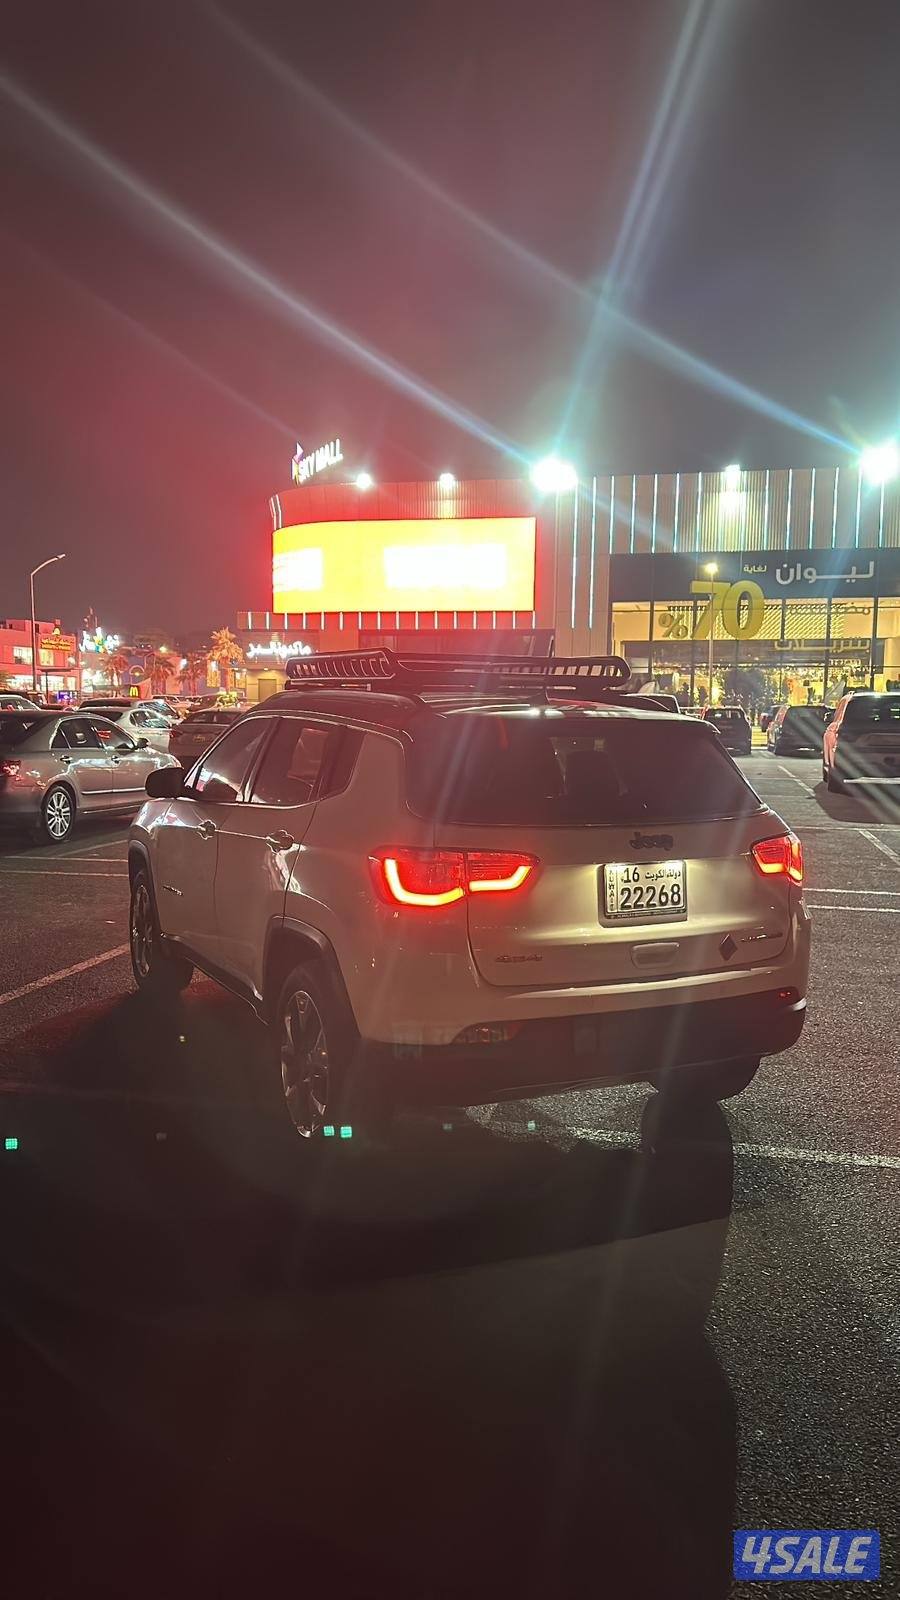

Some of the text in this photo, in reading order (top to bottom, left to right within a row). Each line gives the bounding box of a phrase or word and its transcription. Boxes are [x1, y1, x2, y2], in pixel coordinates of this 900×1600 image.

[743, 564, 767, 574] لغاية
[775, 560, 875, 585] ليوان
[623, 867, 640, 884] 16
[620, 883, 681, 909] 22268
